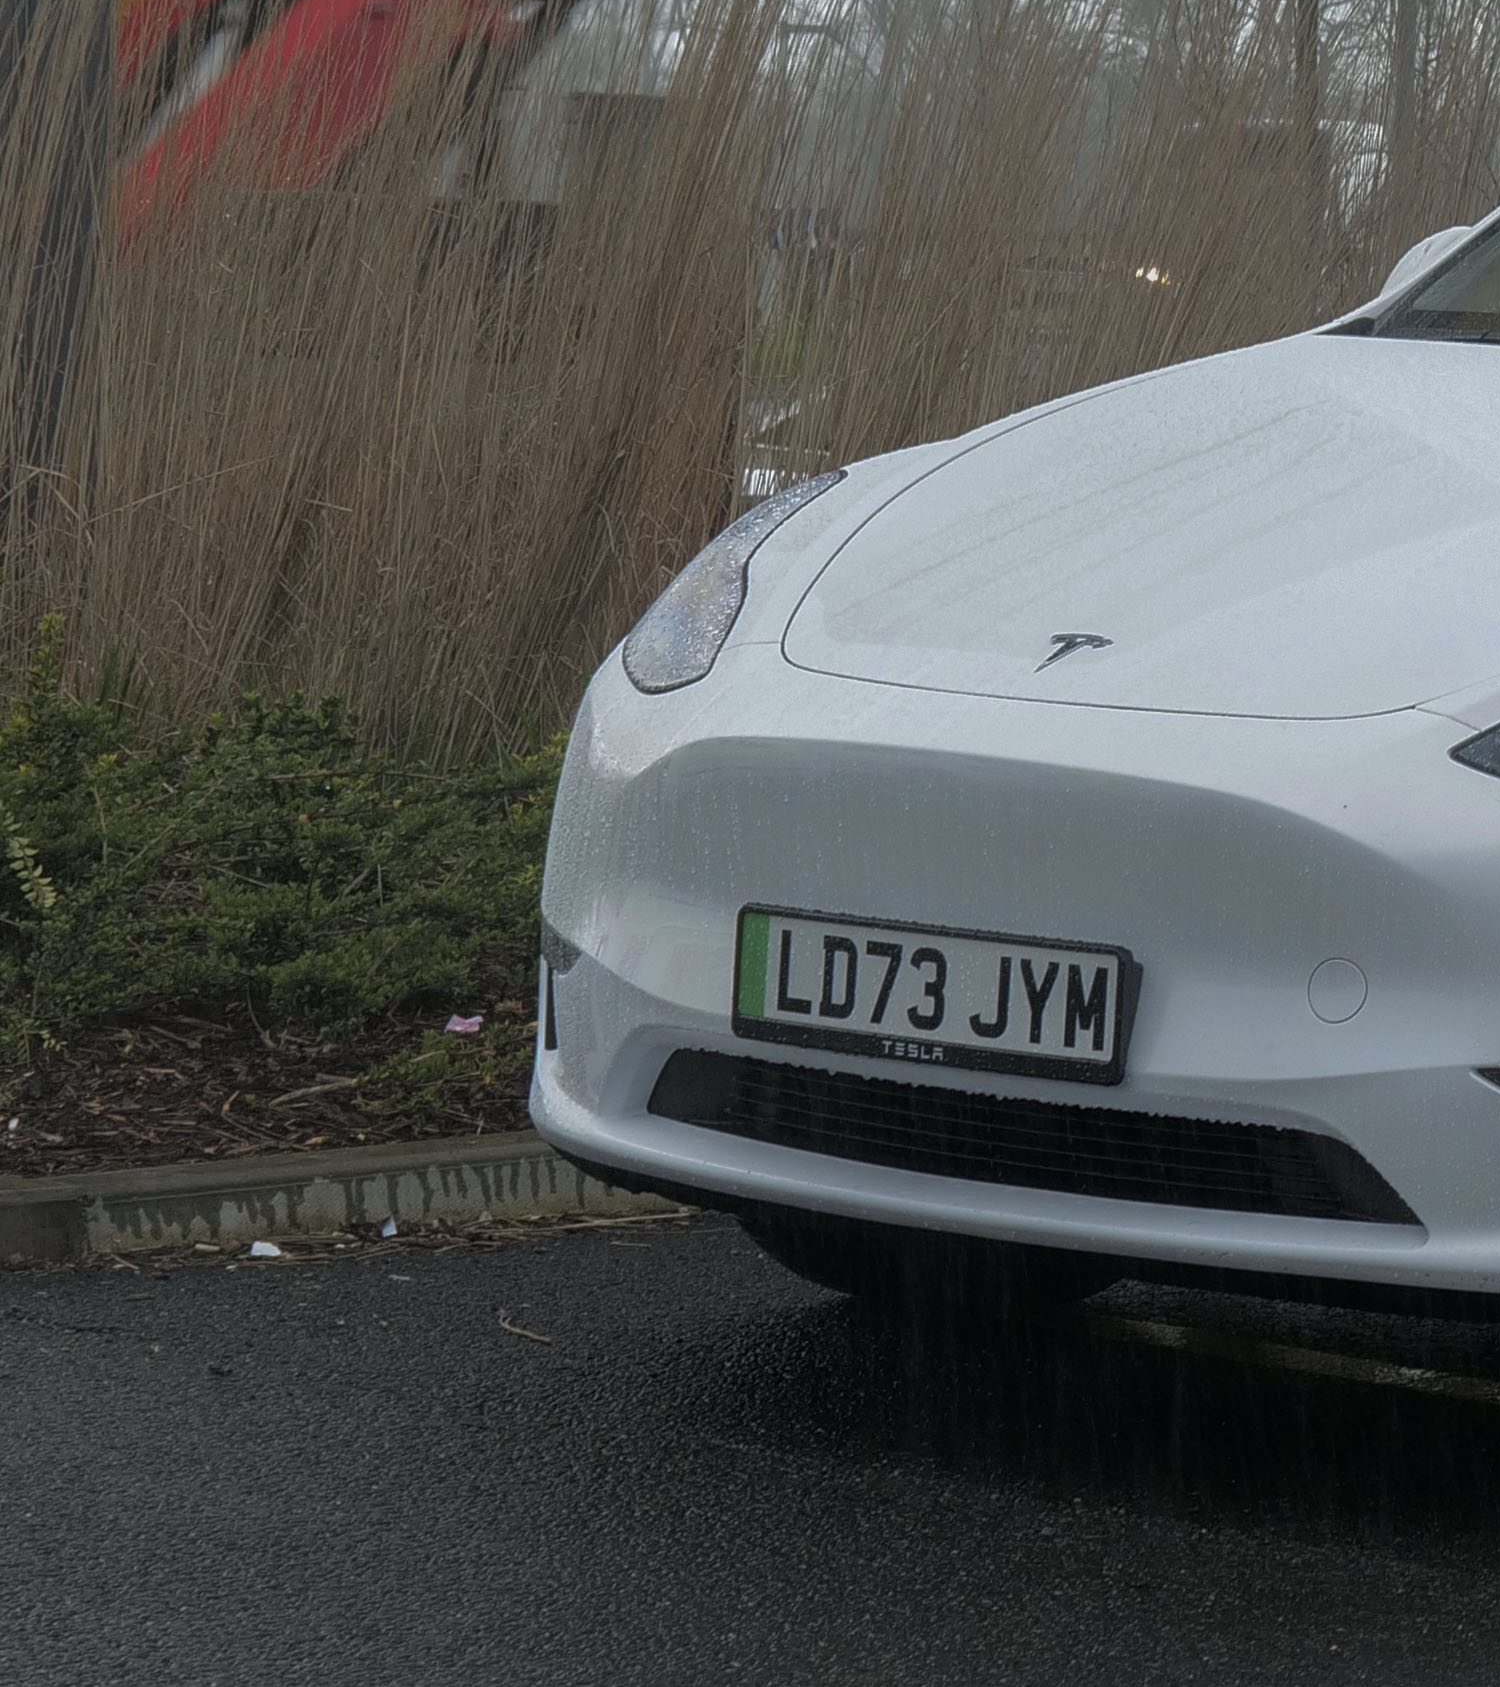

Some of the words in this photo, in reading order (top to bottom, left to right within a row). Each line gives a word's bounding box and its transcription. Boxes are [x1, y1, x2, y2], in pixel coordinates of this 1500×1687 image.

[776, 928, 949, 1032] LD73
[968, 955, 1109, 1052] JYM
[881, 1039, 944, 1061] TESLA
